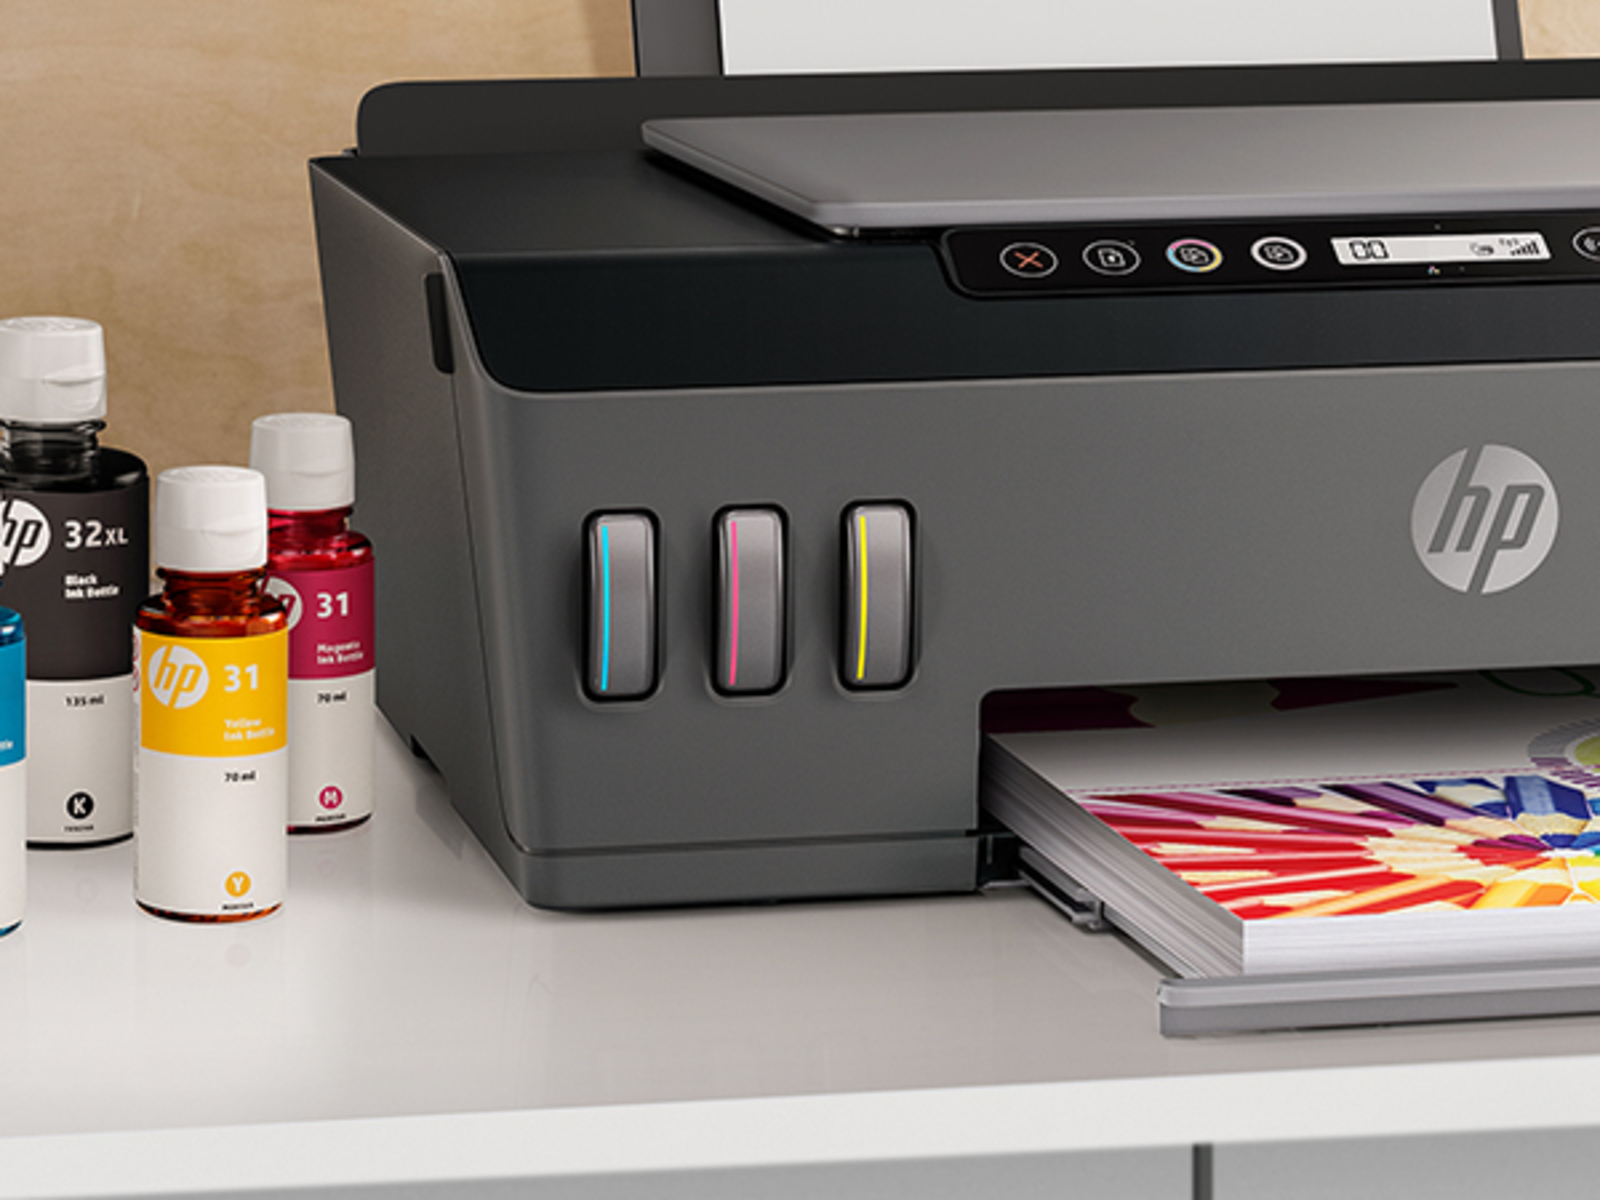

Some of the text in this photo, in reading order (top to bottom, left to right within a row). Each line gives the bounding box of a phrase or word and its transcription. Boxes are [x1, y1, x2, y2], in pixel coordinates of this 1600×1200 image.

[1416, 445, 1554, 594] hp
[316, 592, 349, 619] 31
[150, 645, 207, 709] hp
[223, 664, 259, 692] 31
[73, 796, 87, 815] K
[231, 876, 245, 894] Y
